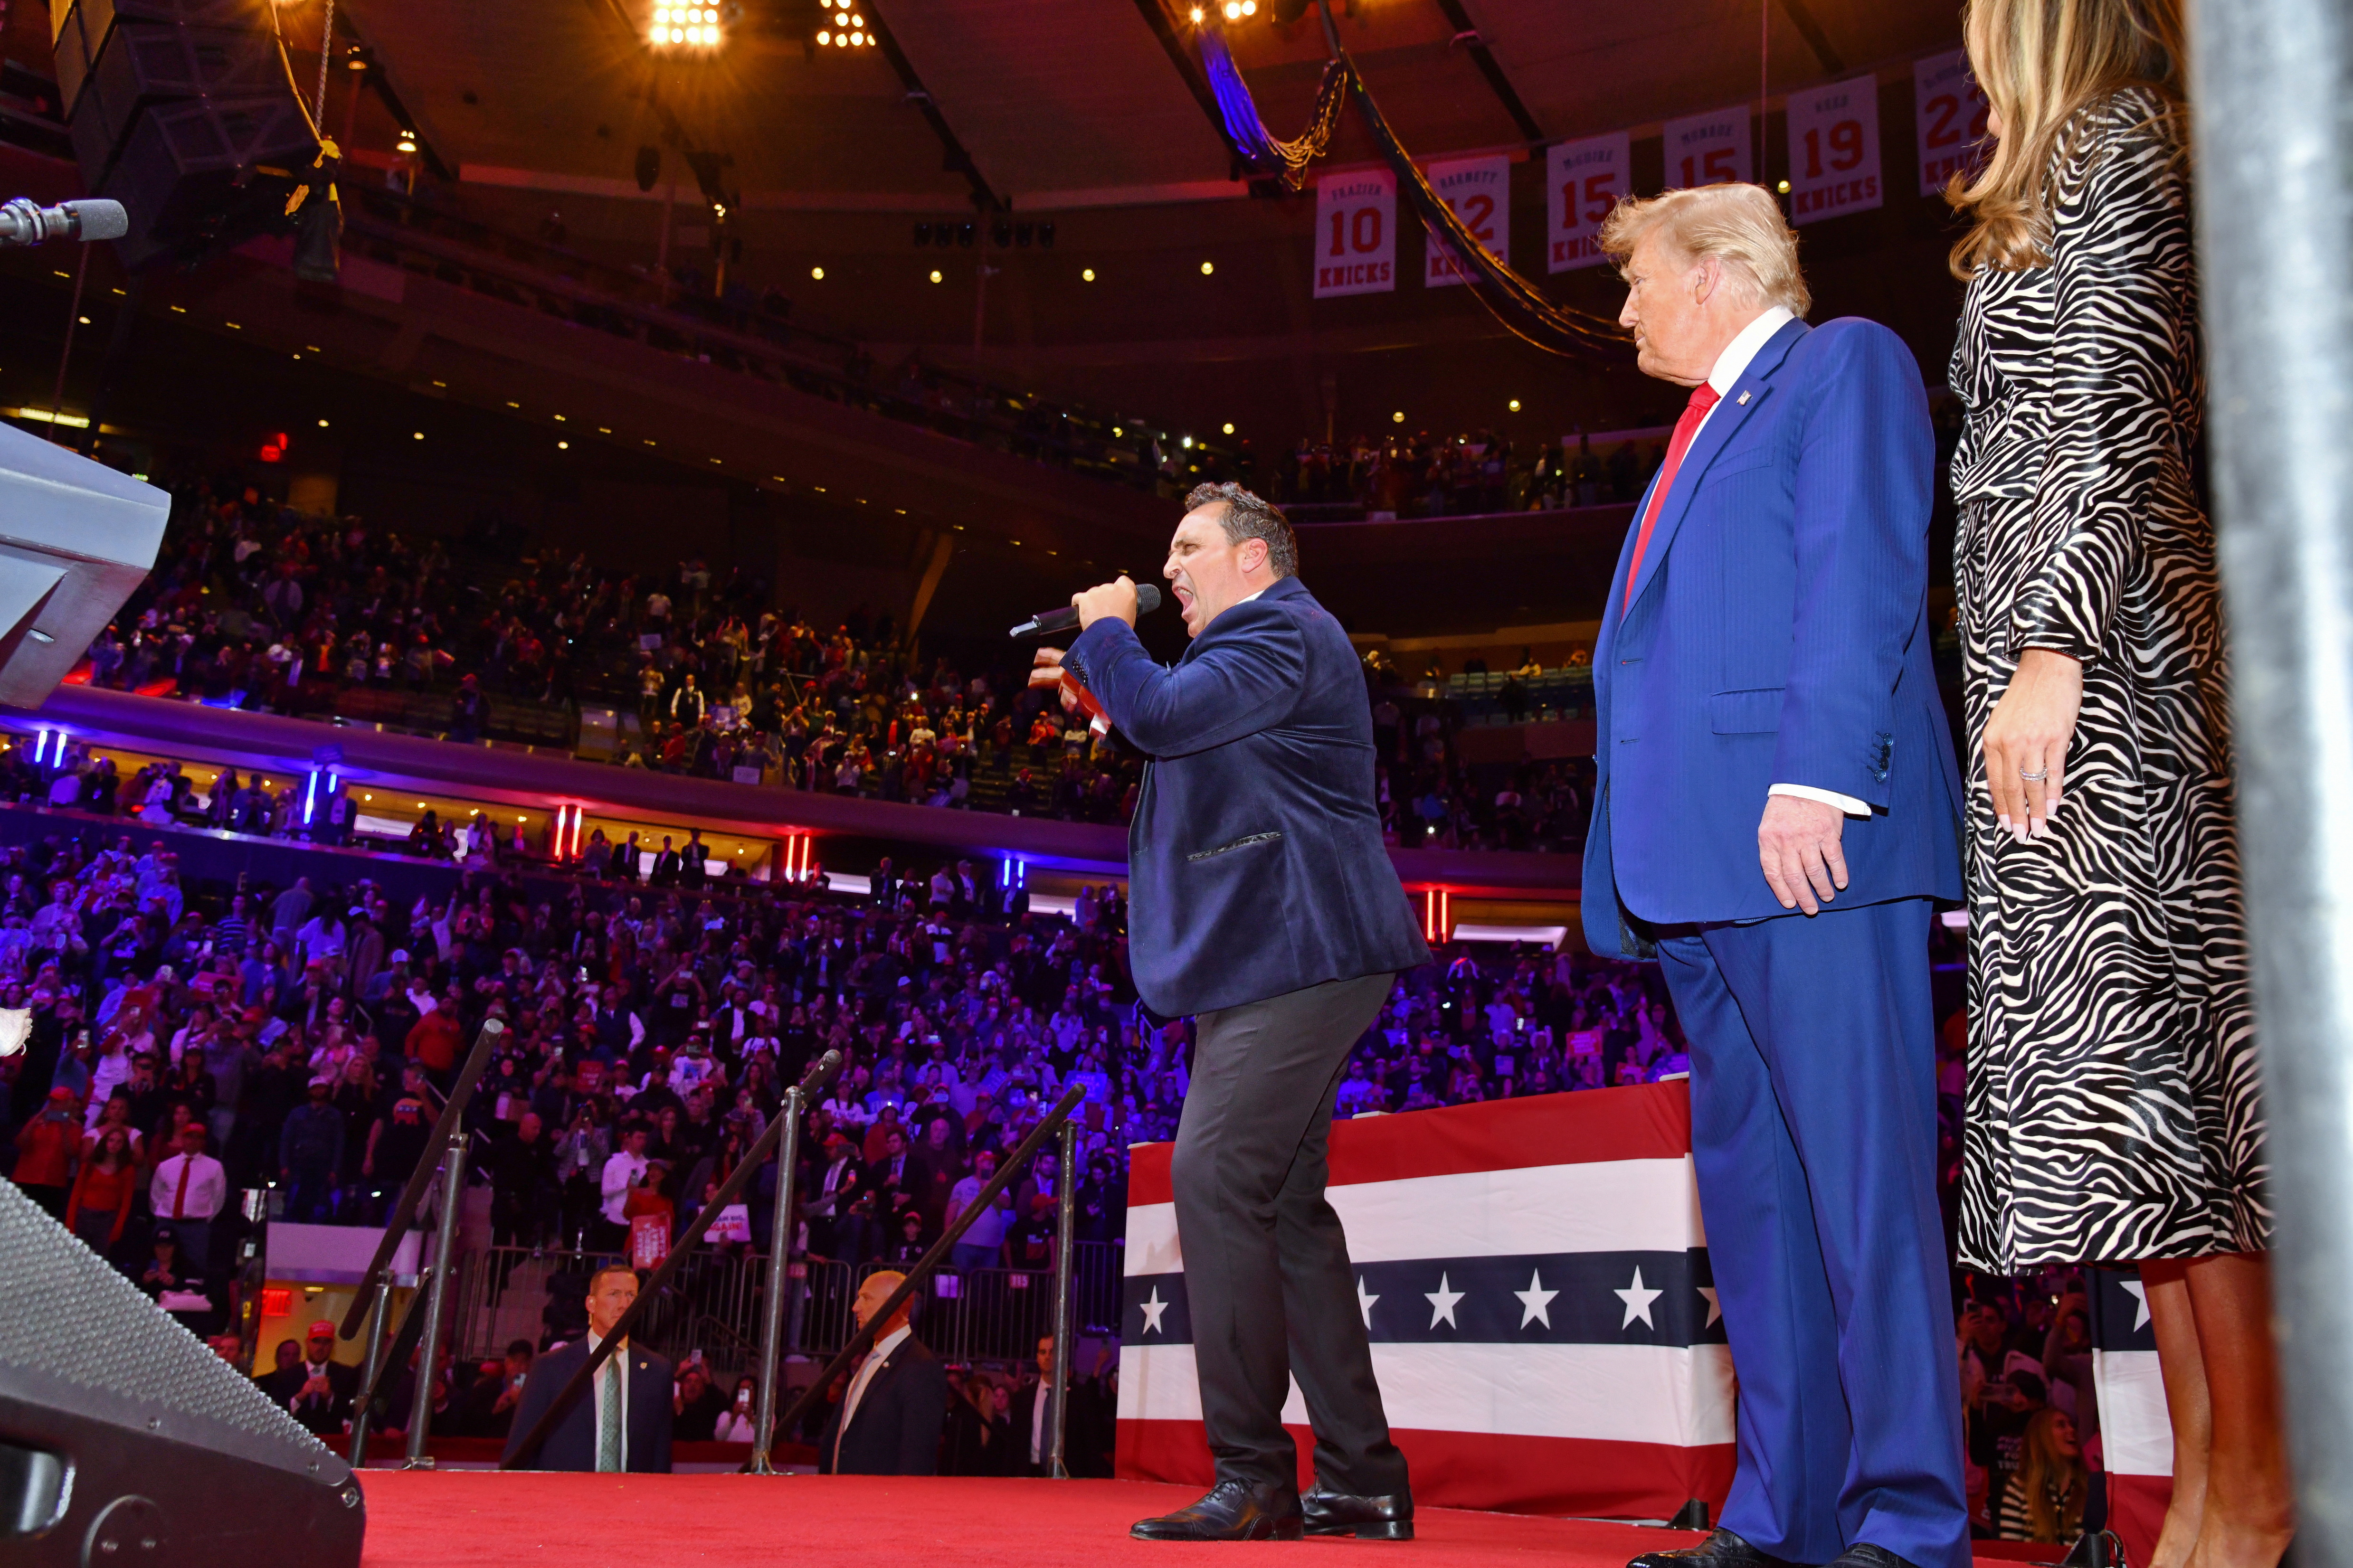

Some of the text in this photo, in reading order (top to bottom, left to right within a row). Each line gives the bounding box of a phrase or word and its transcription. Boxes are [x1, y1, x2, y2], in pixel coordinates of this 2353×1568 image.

[1681, 148, 1736, 189] 15
[1805, 120, 1862, 179] 19
[1331, 183, 1382, 200] FRAZIER
[1563, 173, 1615, 228] 15
[1796, 176, 1877, 214] KNICKS
[1330, 207, 1381, 256] 10
[1553, 235, 1602, 263] KNIC
[1319, 261, 1389, 288] KNICKS
